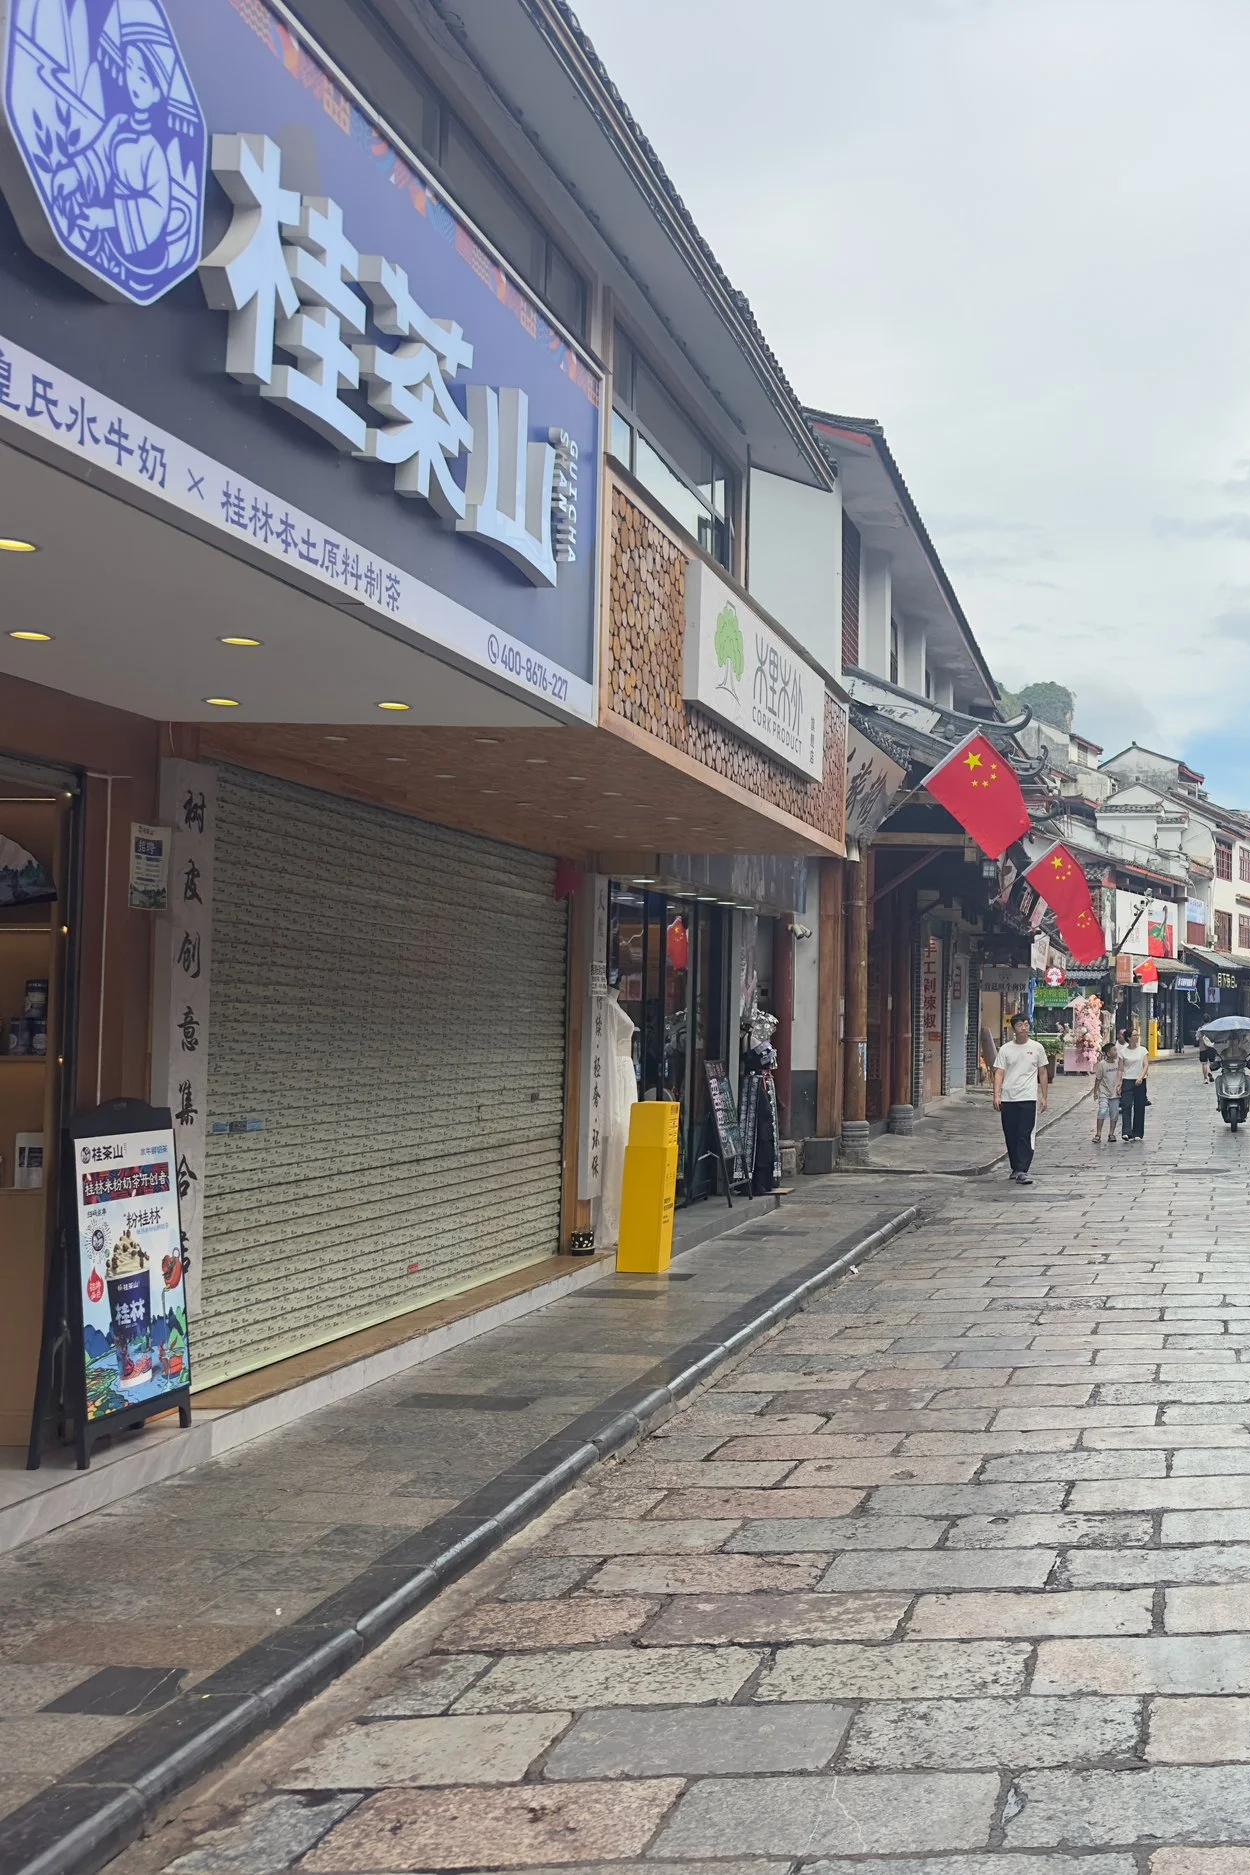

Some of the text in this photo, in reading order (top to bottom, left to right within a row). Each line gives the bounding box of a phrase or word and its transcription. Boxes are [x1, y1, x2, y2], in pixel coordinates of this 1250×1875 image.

[203, 133, 557, 588] 桂茶山
[567, 438, 579, 563] GUICHA
[220, 480, 401, 612] 桂林本土原料制茶
[500, 644, 569, 702] 400-8676-227
[751, 706, 772, 734] CORK
[772, 723, 803, 755] PRODUCT
[92, 1144, 124, 1162] 桂茶山
[84, 1171, 168, 1197] 桂林米粉奶茶开创者
[115, 1298, 147, 1326] 桂林
